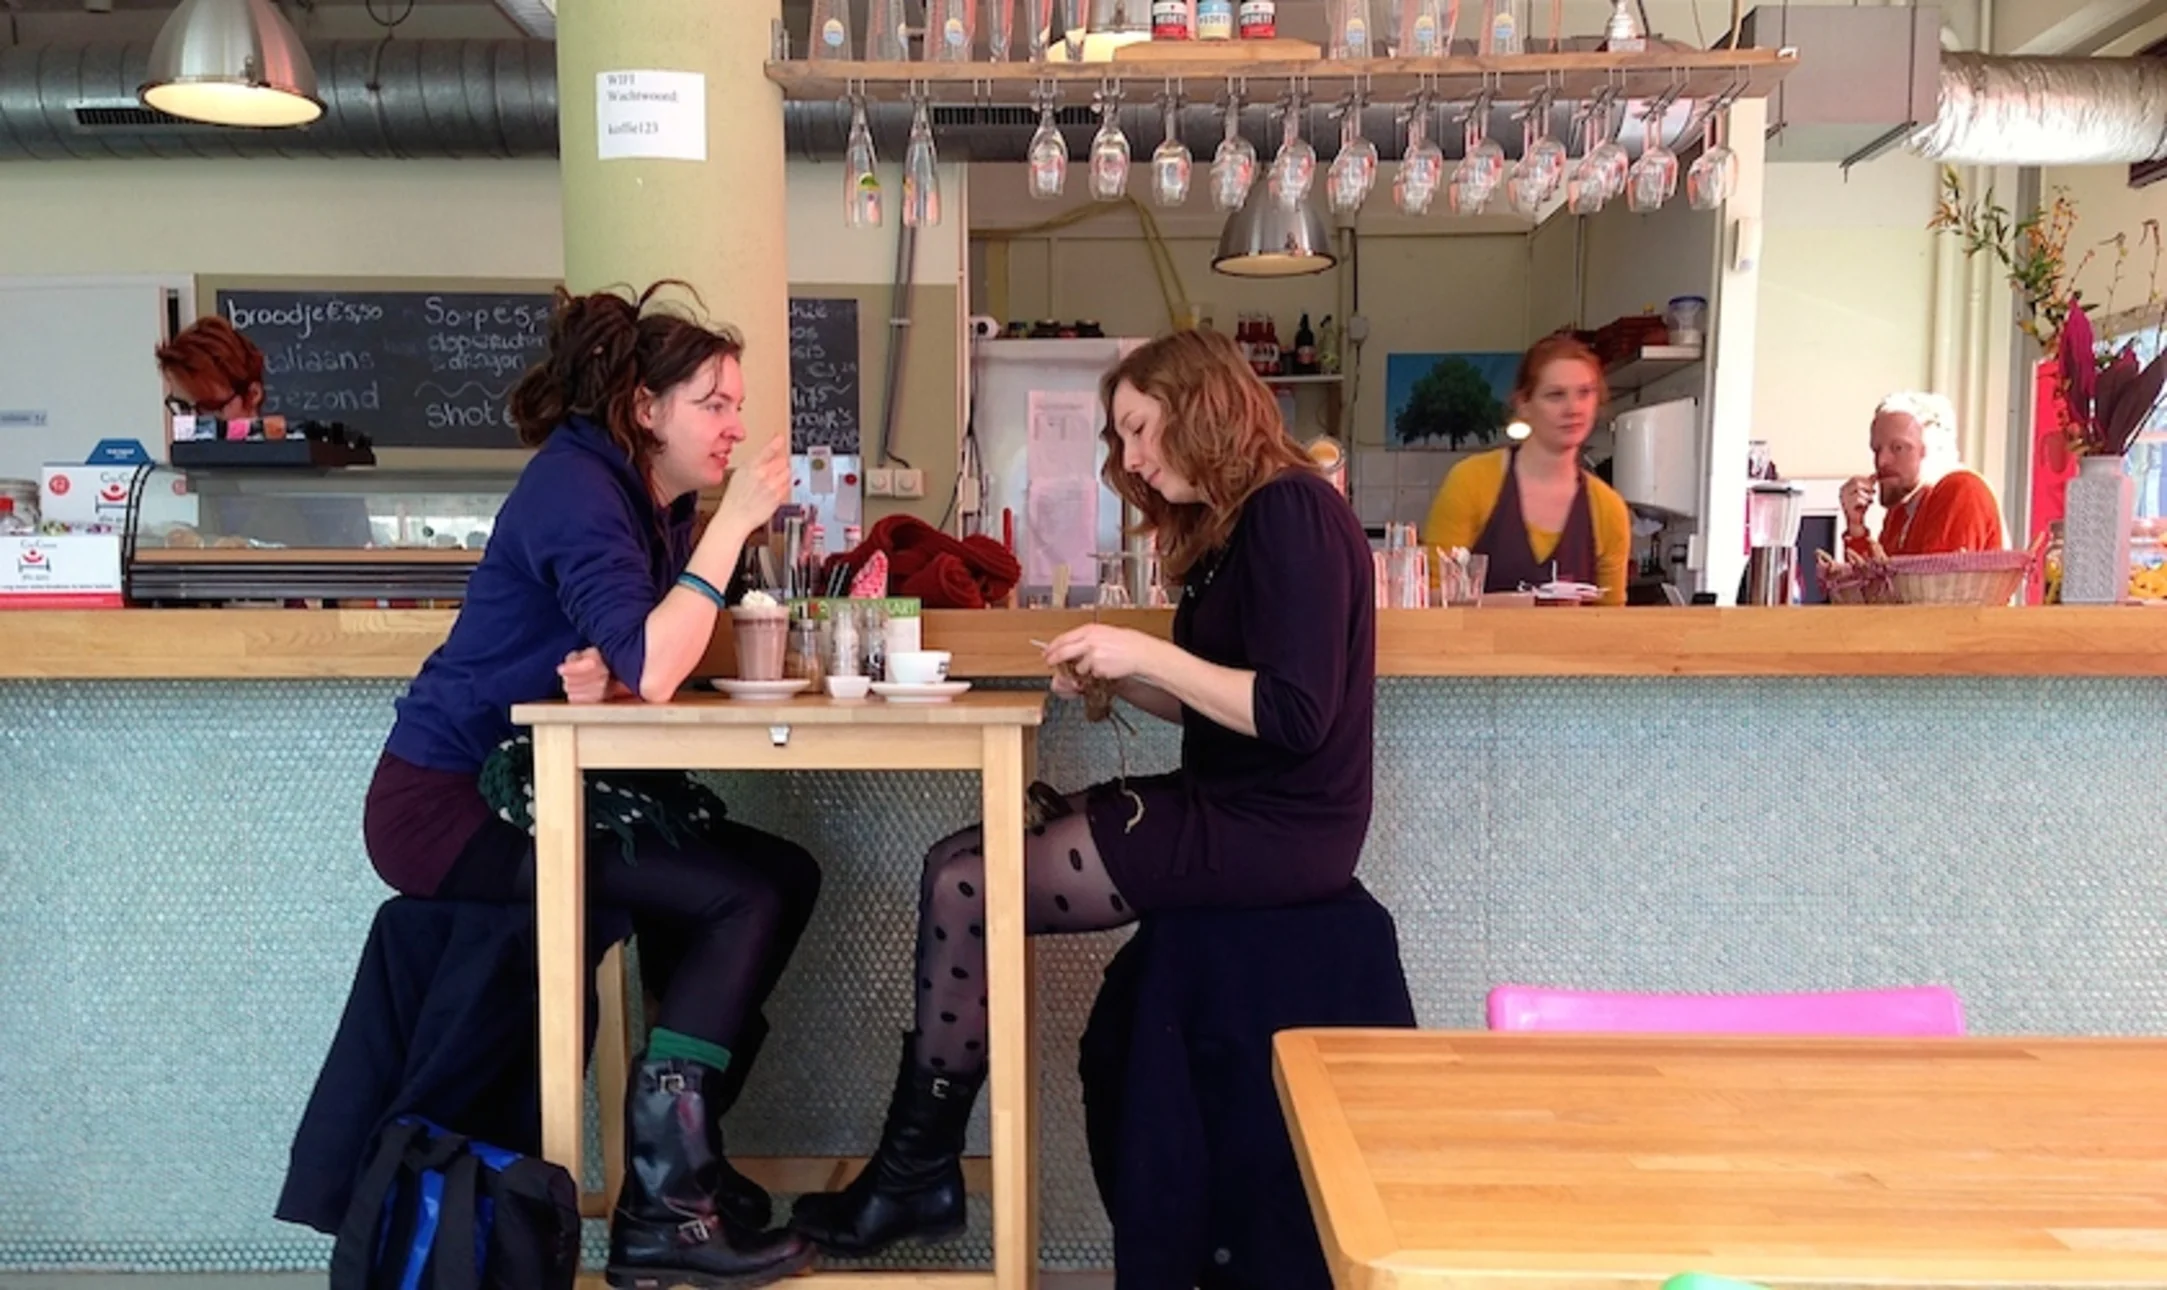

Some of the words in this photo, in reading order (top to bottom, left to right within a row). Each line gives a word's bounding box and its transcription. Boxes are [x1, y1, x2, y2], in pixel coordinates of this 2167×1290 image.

[608, 121, 659, 135] koffie123
[227, 300, 323, 339] broodje
[425, 400, 497, 428] shot
